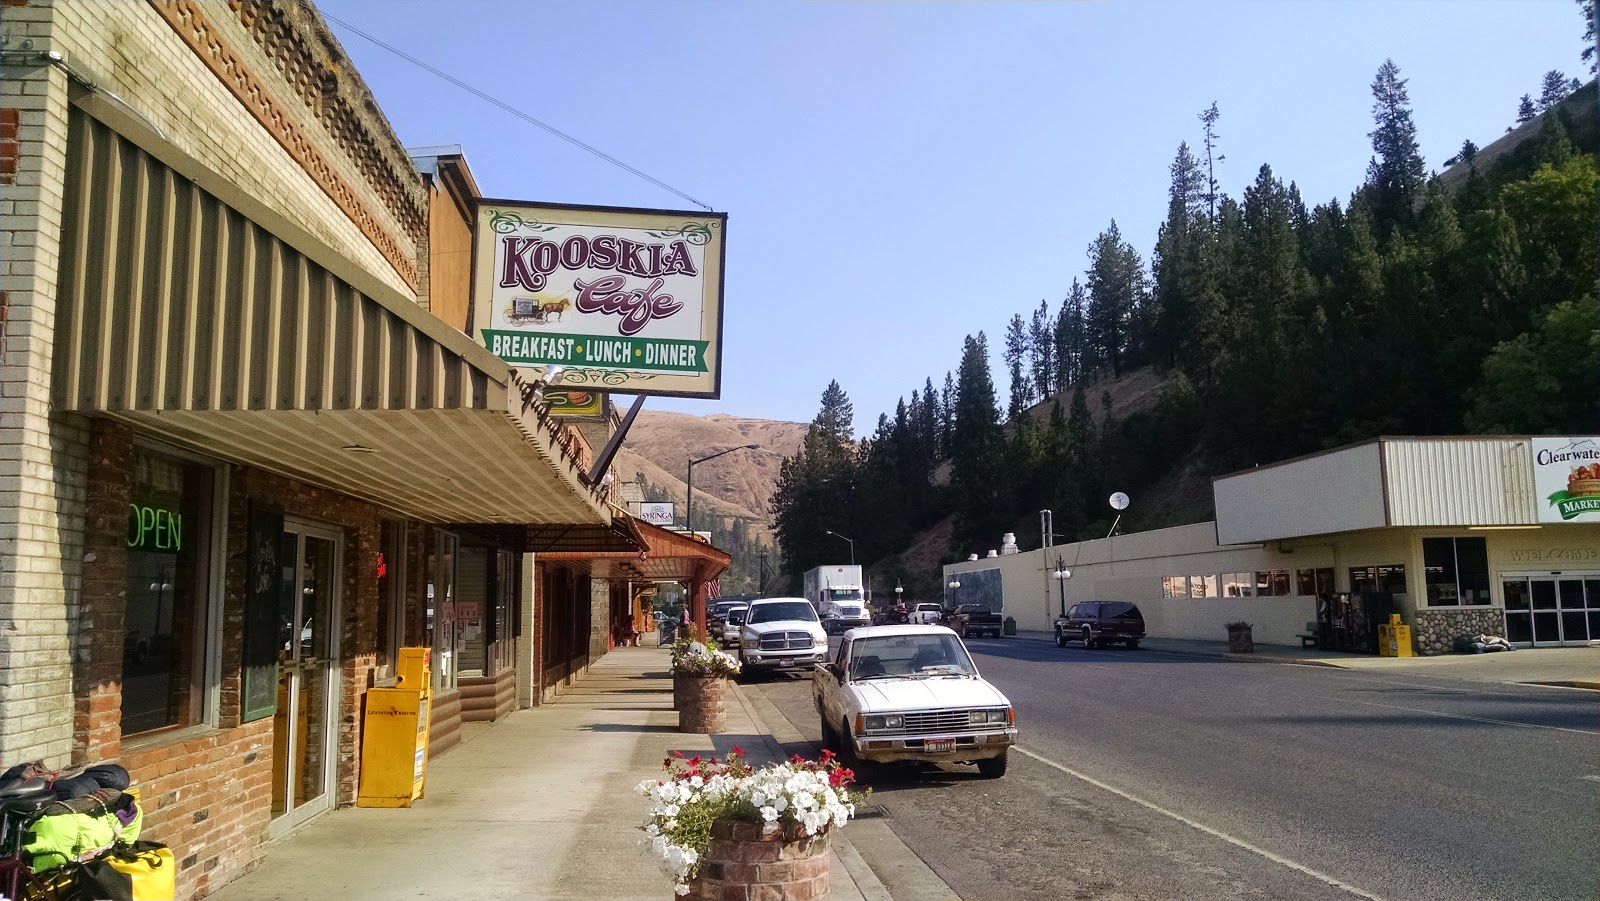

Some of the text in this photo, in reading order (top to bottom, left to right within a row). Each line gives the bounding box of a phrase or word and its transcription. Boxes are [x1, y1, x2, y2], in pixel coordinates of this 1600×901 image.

[500, 234, 698, 292] KOOSKIA
[574, 276, 685, 336] Cafe
[492, 334, 697, 367] BREAKFAST LUNCH DINNER
[1537, 449, 1600, 466] Clearwate
[1563, 499, 1600, 513] MARKE
[128, 503, 182, 552] OPEN
[1510, 548, 1598, 562] WELCOME
